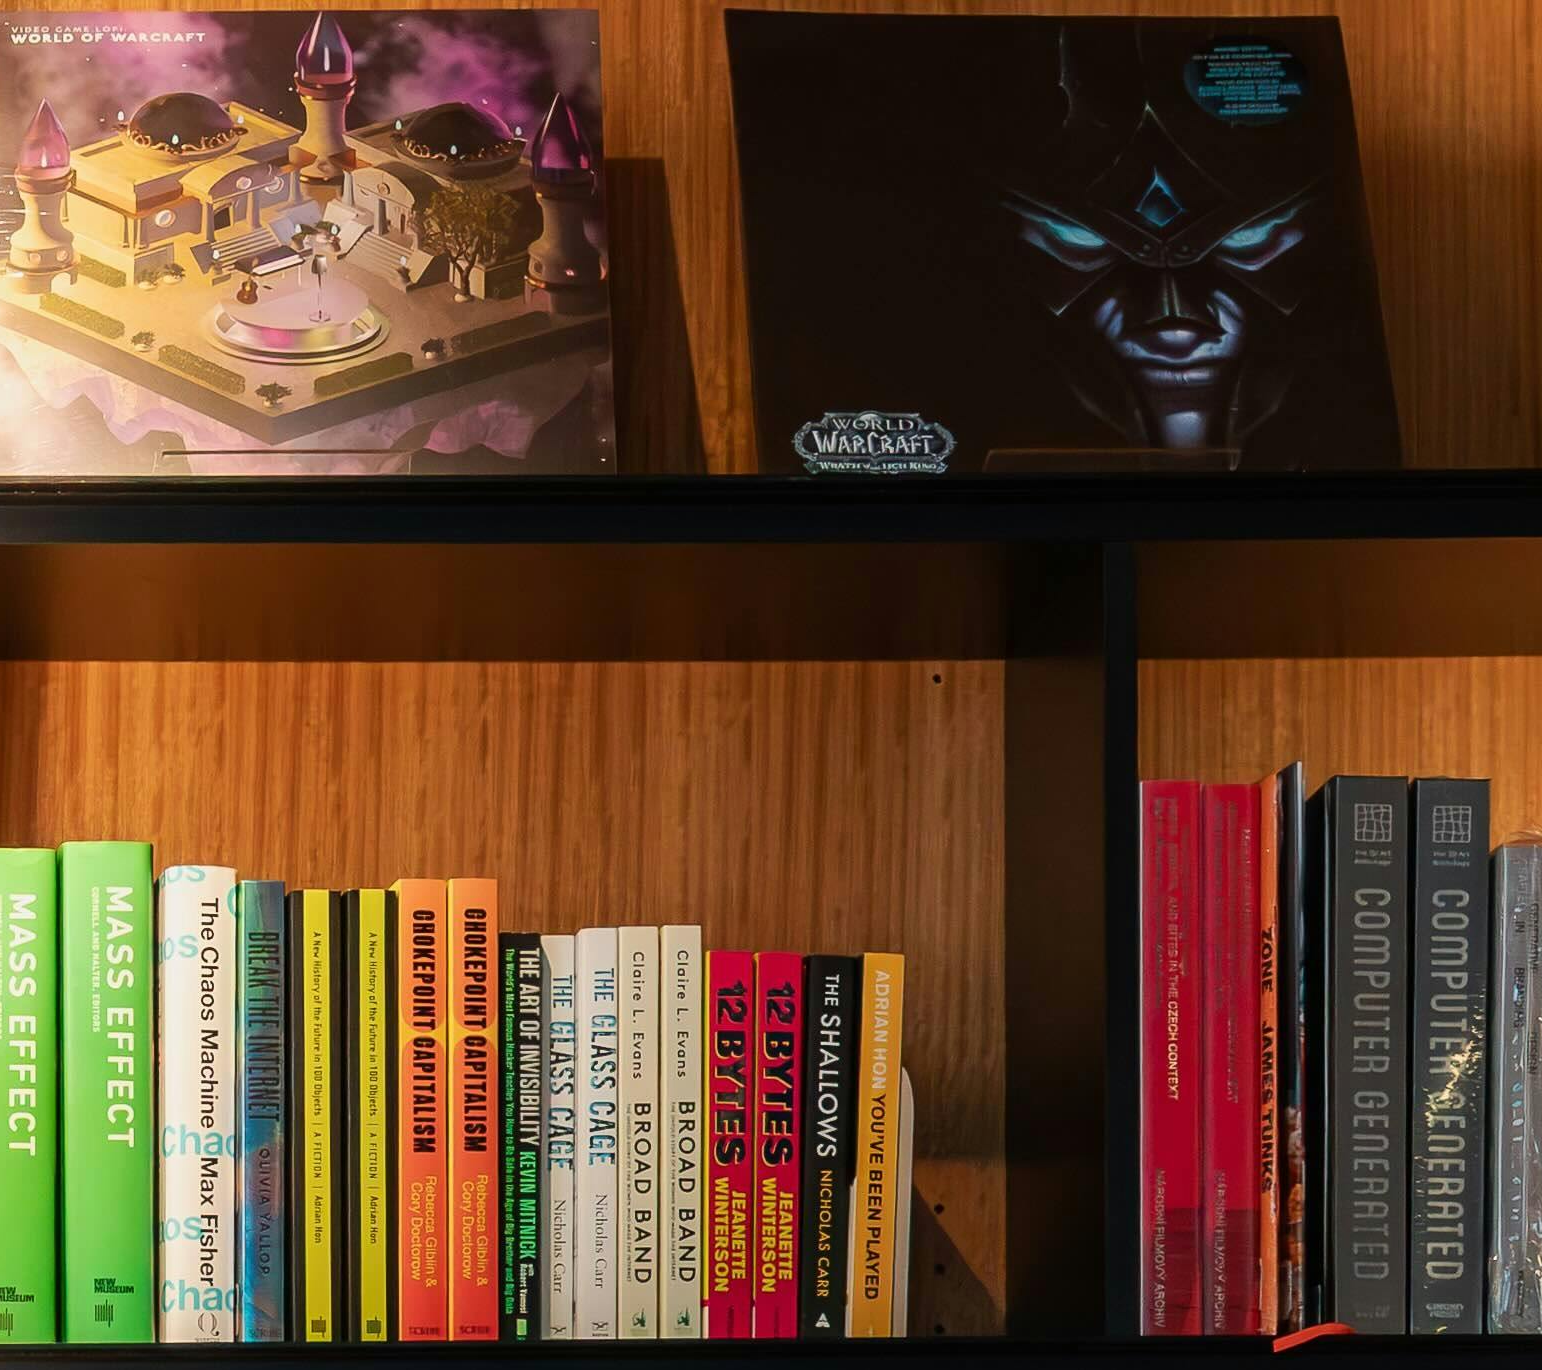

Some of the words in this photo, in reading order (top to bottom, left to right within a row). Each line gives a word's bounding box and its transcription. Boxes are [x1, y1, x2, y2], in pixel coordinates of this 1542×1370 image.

[11, 32, 75, 45] WORLD
[80, 31, 104, 43] OF
[110, 31, 206, 43] WARCRAFT
[105, 886, 133, 991] MASS
[201, 897, 219, 941] The
[200, 942, 219, 1019] Chaos
[463, 908, 487, 1031] CHOKEPOINT
[633, 951, 644, 1001] Claire
[765, 982, 796, 1022] 12
[820, 973, 841, 1008] THE
[1353, 888, 1392, 1074] COMPUTER
[632, 1032, 643, 1080] Evans
[633, 1008, 644, 1023] L.
[106, 1008, 134, 1147] EFFECT
[200, 1029, 219, 1129] Machine
[463, 1034, 487, 1153] CAPITALISM
[762, 1030, 794, 1167] BYTES
[817, 1013, 840, 1159] SHALLOWS
[199, 1157, 217, 1208] Max
[634, 1102, 652, 1195] BROAD
[1352, 1090, 1390, 1281] GENERATED
[199, 1213, 219, 1287] Fisher
[634, 1209, 652, 1284] BAND
[761, 1177, 777, 1293] WINTERSON
[778, 1191, 794, 1281] JEANETTE
[819, 1169, 834, 1254] NICHOLAS
[816, 1258, 831, 1298] CARR
